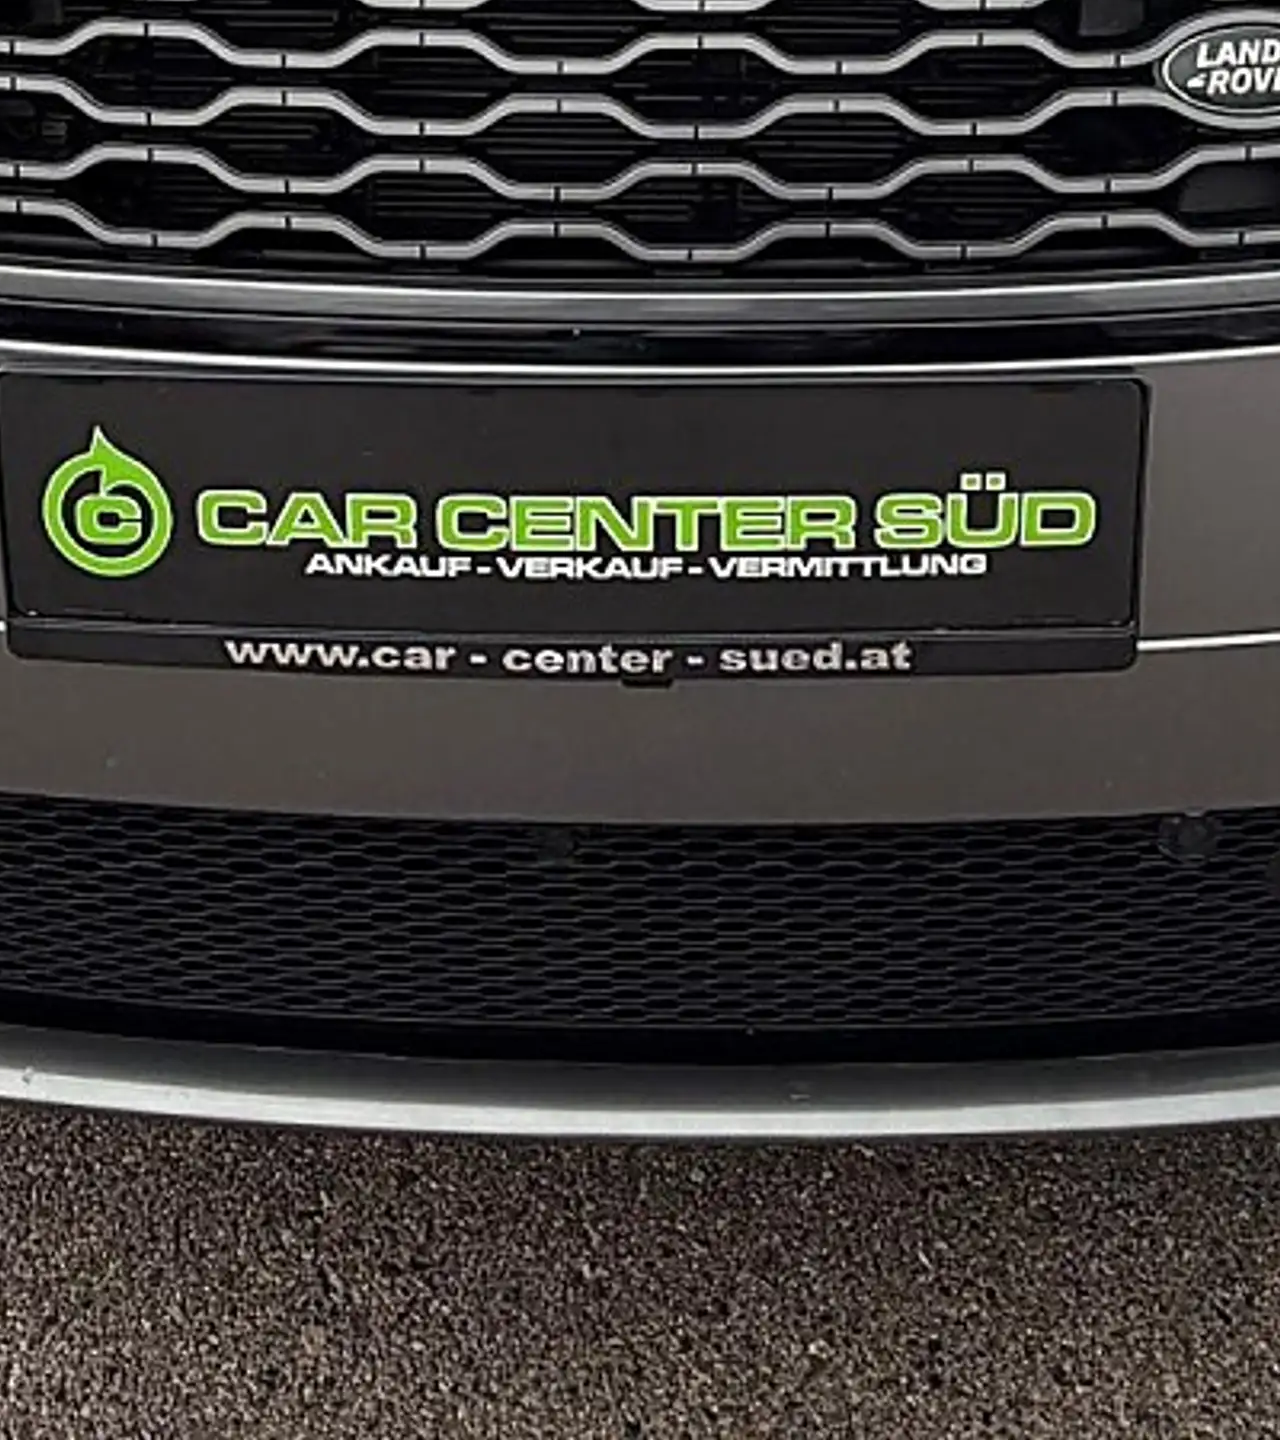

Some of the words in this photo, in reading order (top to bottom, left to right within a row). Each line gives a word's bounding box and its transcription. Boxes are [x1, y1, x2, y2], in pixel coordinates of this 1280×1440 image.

[197, 489, 417, 548] CAR
[435, 494, 856, 551] CENTER
[874, 472, 1097, 548] SÜD
[305, 553, 471, 577] ANKAUF
[496, 556, 682, 578] VERKAUF
[708, 553, 987, 578] VERMITTLUNG
[224, 640, 456, 670] www.car
[502, 643, 674, 674] center
[720, 640, 912, 672] sued.at
